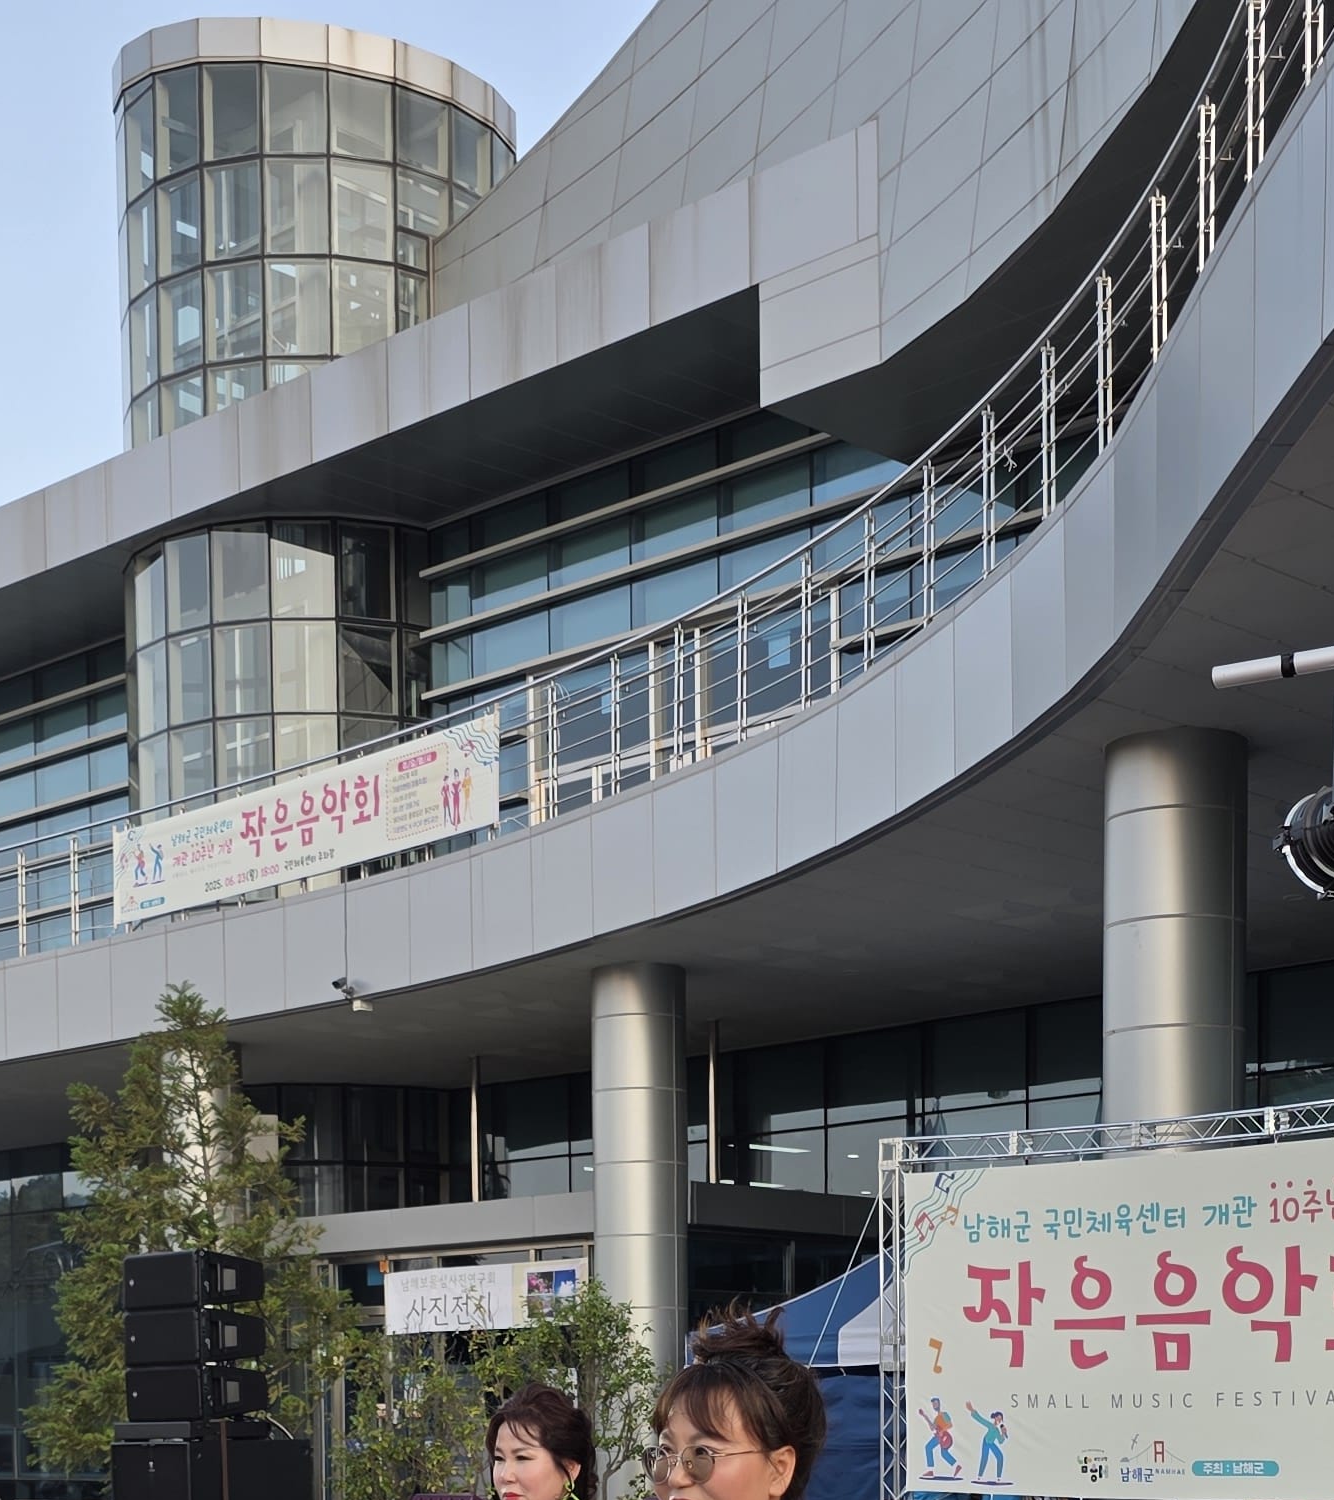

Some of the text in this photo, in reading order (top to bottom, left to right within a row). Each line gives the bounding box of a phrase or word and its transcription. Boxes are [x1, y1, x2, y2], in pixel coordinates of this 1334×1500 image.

[238, 774, 382, 860] 작은음악회
[963, 1211, 1032, 1244] 남해군
[1042, 1202, 1187, 1241] 국민체육센터
[1202, 1195, 1258, 1229] 개관
[1010, 1393, 1090, 1409] SMALL
[1110, 1392, 1194, 1409] MUSIC
[1119, 1466, 1155, 1483] 남해군
[1202, 1461, 1224, 1476] 주최
[1231, 1461, 1265, 1476] 남해군
